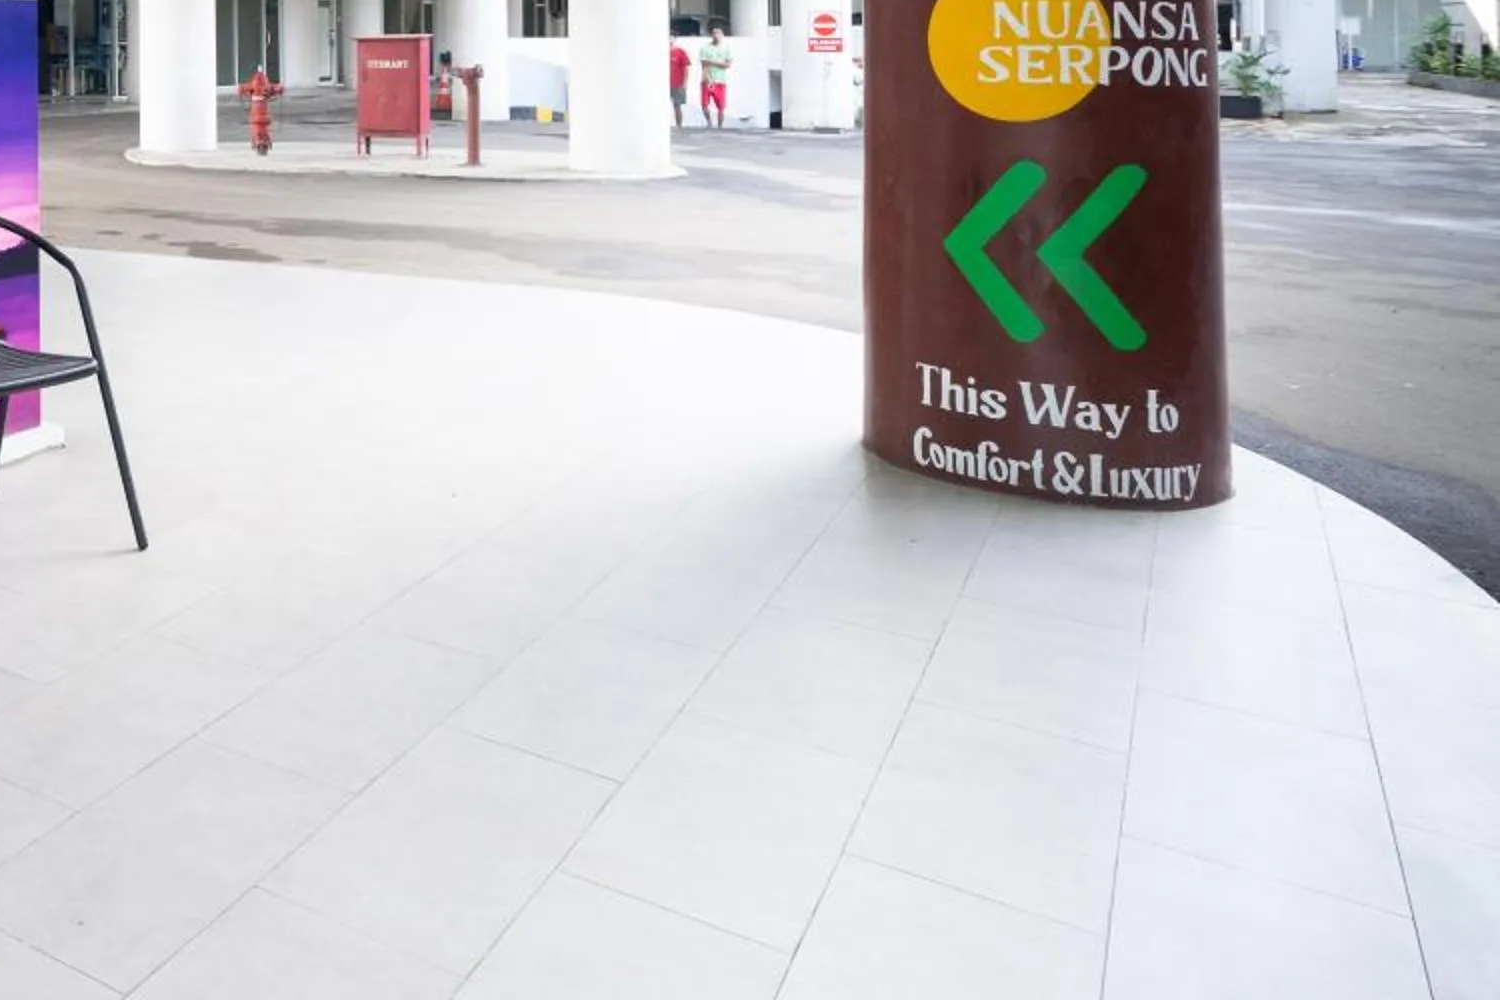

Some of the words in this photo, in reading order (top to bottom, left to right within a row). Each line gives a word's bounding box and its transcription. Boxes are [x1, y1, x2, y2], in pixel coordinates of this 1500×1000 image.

[993, 0, 1200, 41] NUANSA
[977, 45, 1208, 87] SERPONG
[915, 361, 1008, 420] This
[1017, 381, 1131, 439] Way
[1146, 389, 1180, 433] to
[913, 425, 1046, 490] Comfort
[1089, 454, 1202, 502] Luxury
